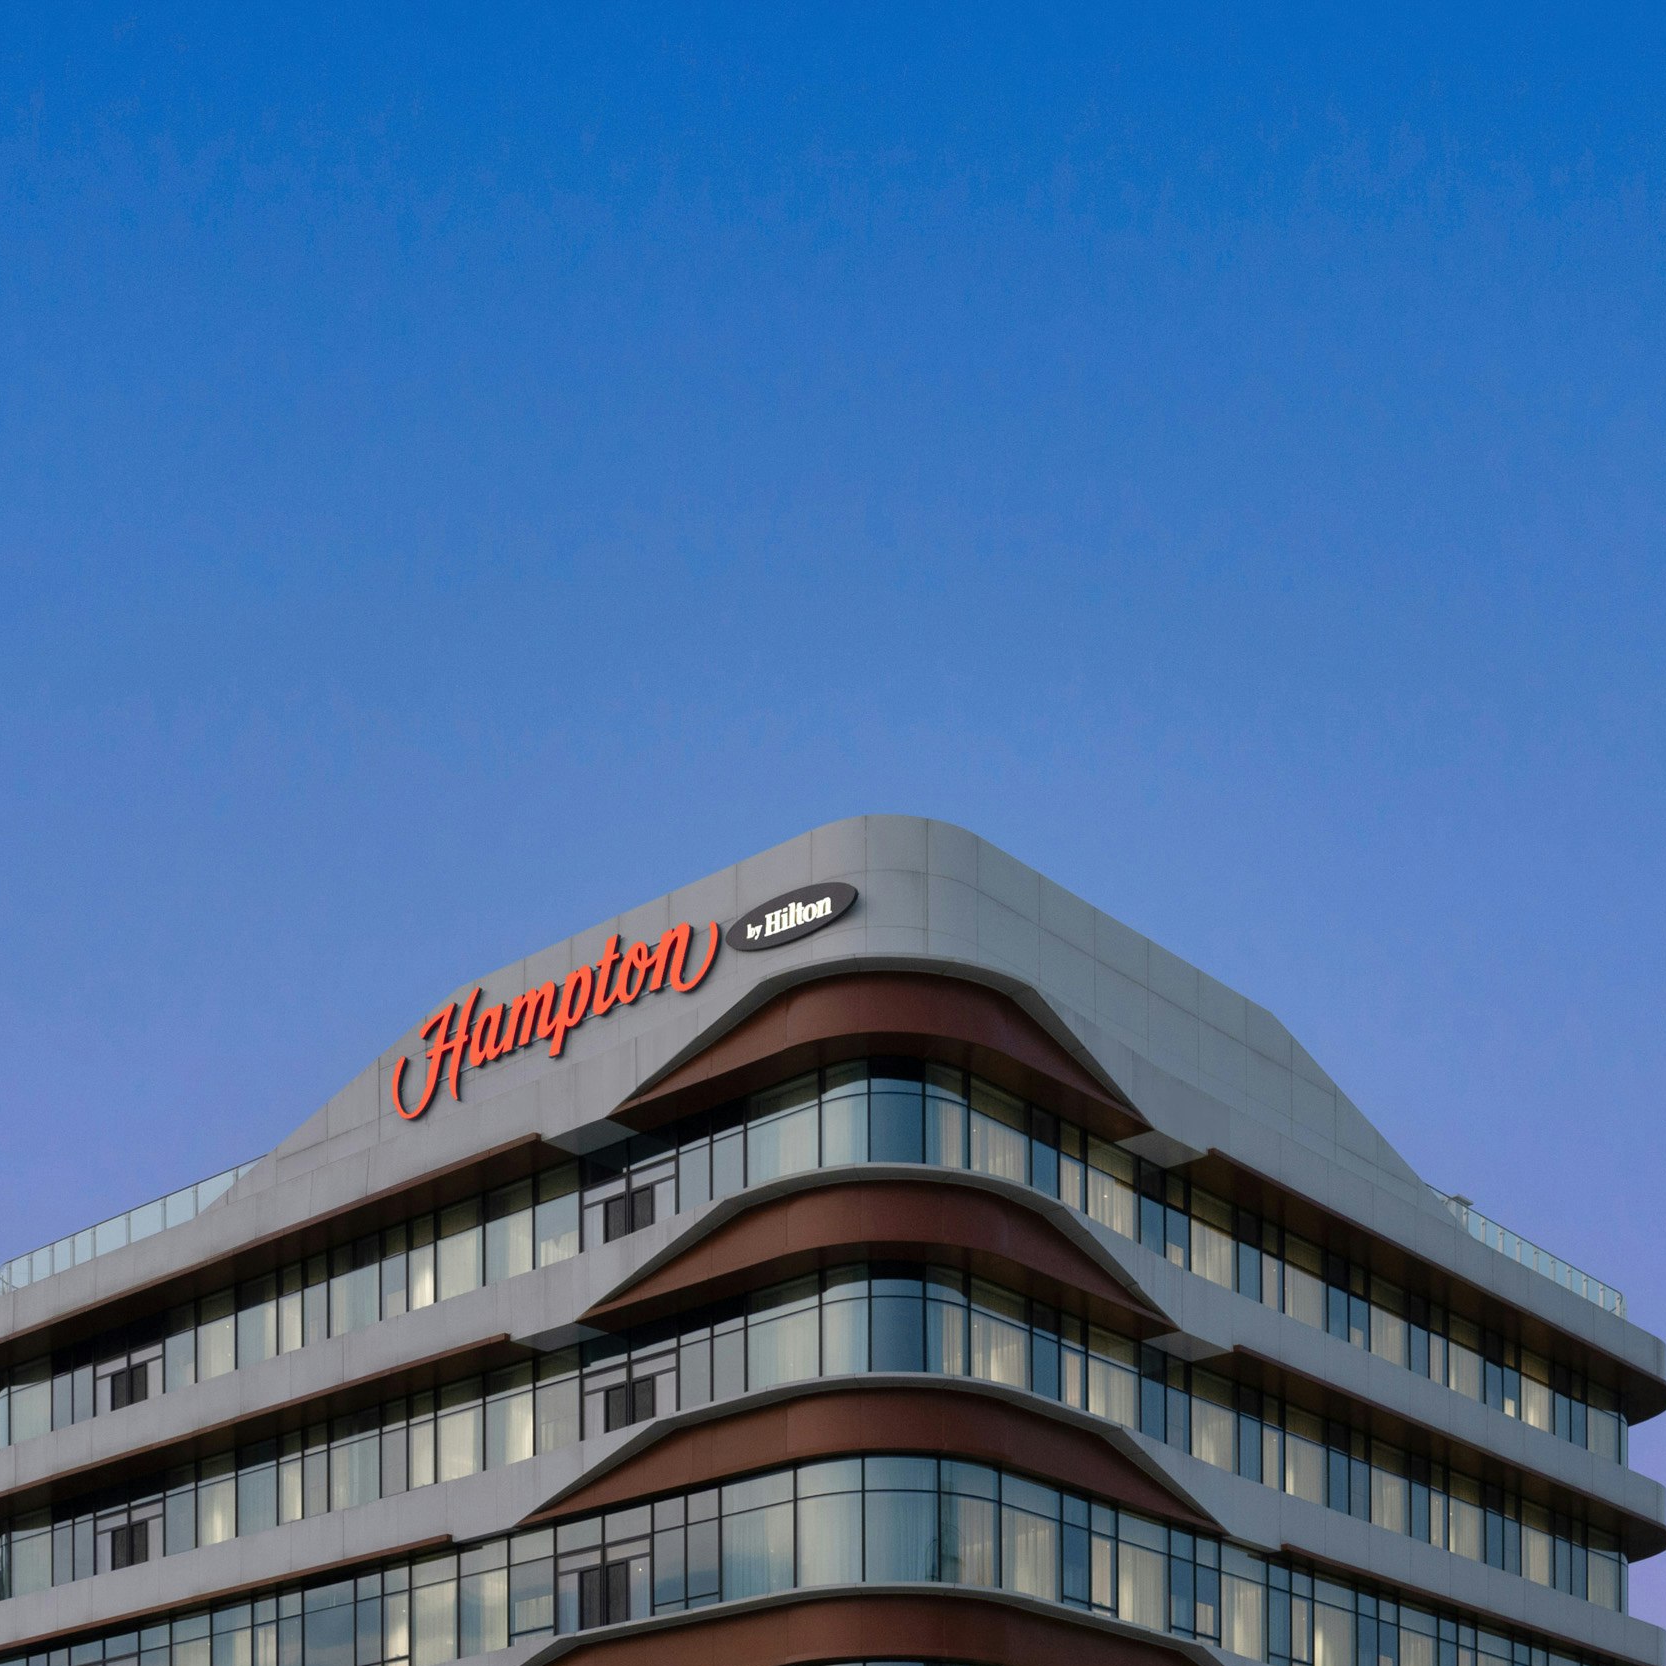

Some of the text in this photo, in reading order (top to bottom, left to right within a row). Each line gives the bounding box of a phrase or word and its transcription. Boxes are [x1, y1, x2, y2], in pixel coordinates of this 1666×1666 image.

[746, 897, 832, 940] by Hilton
[391, 921, 719, 1121] Hampton
